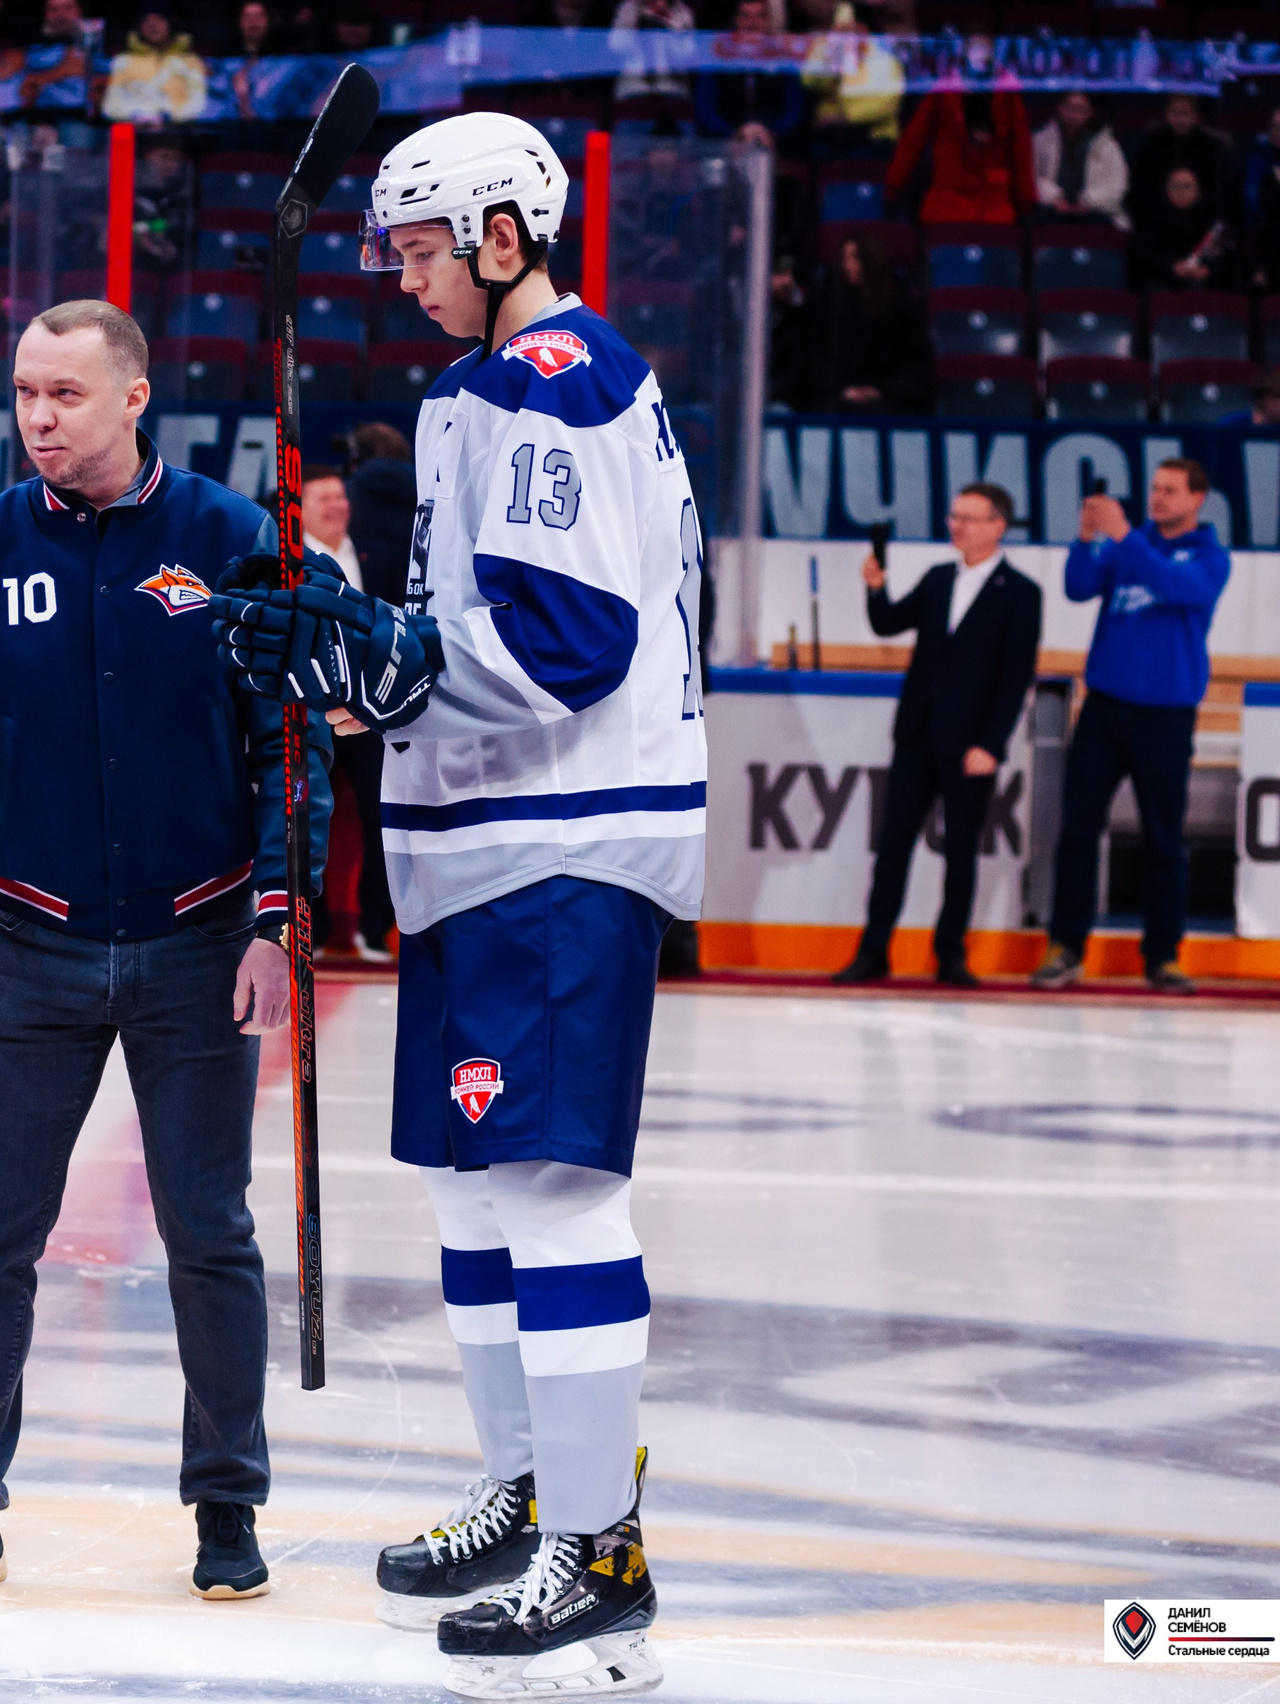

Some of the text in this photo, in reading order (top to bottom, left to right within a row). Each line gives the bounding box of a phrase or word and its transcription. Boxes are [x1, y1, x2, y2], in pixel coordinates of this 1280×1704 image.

[472, 177, 514, 197] CCM
[506, 443, 582, 531] 13
[2, 572, 58, 626] 10
[459, 1066, 492, 1084] НМХЛ
[307, 1214, 323, 1341] SOYUZ
